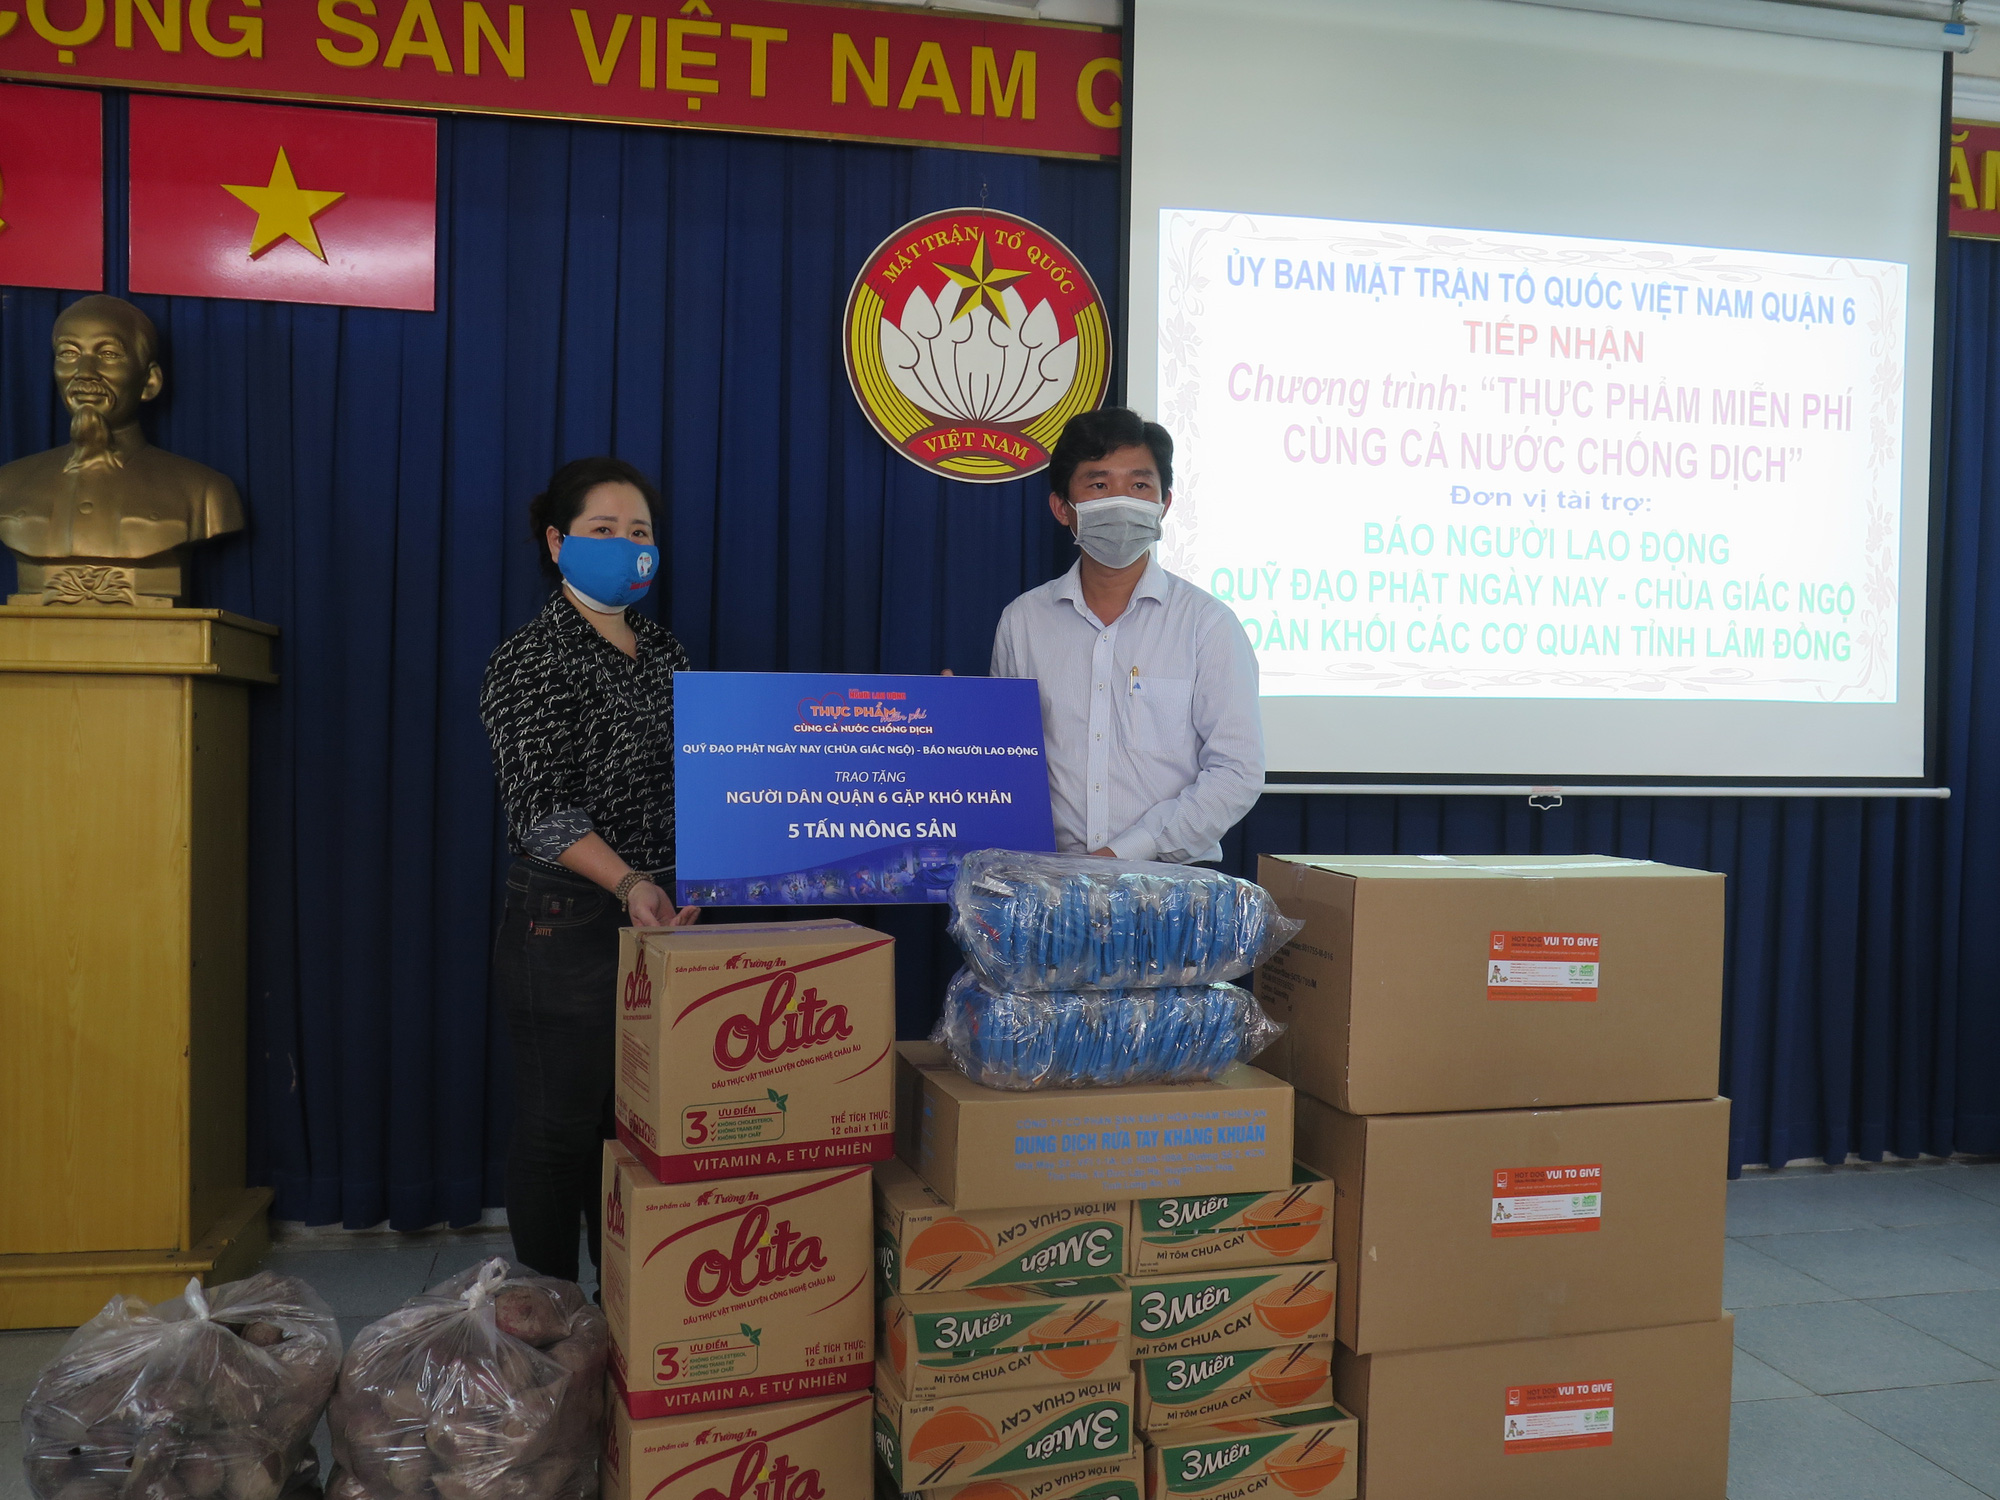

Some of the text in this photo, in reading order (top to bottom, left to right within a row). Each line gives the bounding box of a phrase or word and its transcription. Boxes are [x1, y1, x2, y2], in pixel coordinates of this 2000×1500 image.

[571, 0, 788, 111] VIỆT
[831, 32, 1036, 121] NAM
[881, 224, 1077, 296] MẶT TRẬN TỔ QUỐC
[1227, 247, 1856, 330] ỦY BAN MẶT TRẬN TỔ QUỐC VIỆT NAM QUẬN 6
[1463, 314, 1644, 370] TIẾP NHẬN
[1227, 362, 1370, 417] Chương
[1383, 371, 1467, 412] trình:
[1607, 376, 1700, 424] PHẨM
[1712, 381, 1790, 428] MIỄN
[1802, 387, 1853, 432] PHÍ
[922, 431, 1031, 462] VIỆT NAM
[1283, 416, 1386, 466] CÙNG
[1400, 421, 1449, 468] CẢ
[1461, 425, 1565, 473] NƯỚC
[1577, 431, 1697, 479] CHỐNG
[1450, 485, 1652, 516] Đơn vị tài trợ:
[1364, 515, 1730, 571] BÁO NGƯỜI LAO ĐỘNG
[1210, 561, 1855, 623] QUỸ ĐẠO PHẬT NGÀY NAY CHÙA GIÁC NGỘ
[1239, 610, 1851, 662] OÀN KHỐI CÁC CƠ QUAN TỈNH LÂM ĐỒNG
[810, 705, 852, 720] THỰC
[793, 722, 933, 735] CÙNG CẢ NƯỚC CHỐNG DỊCH
[682, 743, 1038, 759] QUỸ ĐẠO PHẬT NGÀY NAY (CHÙA GIÁC NGỘ) BÁO NGƯỜI LAO ĐỘNG
[834, 770, 906, 786] TRAO TẶNG
[726, 787, 1012, 808] NGƯỜI DÂN QUẬN 6 GẶP KHÓ KHĂN
[788, 817, 957, 839] 5 TẤN NÔNG SẢN
[1543, 936, 1560, 946] VUI
[1562, 937, 1574, 946] TO
[1577, 937, 1599, 947] GIVE
[727, 1076, 745, 1087] THỰC
[759, 1069, 774, 1078] TINH
[774, 1062, 796, 1073] LUYỆN
[796, 1058, 815, 1068] CÔNG
[834, 1047, 852, 1057] CHÂU
[686, 1110, 708, 1145] 3
[718, 1108, 732, 1117] ƯU
[831, 1112, 847, 1125] THỂ
[849, 1112, 867, 1123] TÍCH
[831, 1126, 840, 1136] 12
[841, 1125, 862, 1136] chai
[1014, 1134, 1057, 1155] DUNG
[1062, 1132, 1098, 1156] DỊCH
[1135, 1130, 1159, 1148] TAY
[1163, 1125, 1214, 1147] KHÁNG
[693, 1142, 872, 1172] VITAMIN A, E TỰ NHIÊN
[1546, 1169, 1562, 1180] VUI
[1565, 1169, 1577, 1178] TO
[1579, 1167, 1600, 1178] GIVE
[1157, 1233, 1246, 1260] MÌ TÔM CHUA CAY
[1135, 1313, 1253, 1356] MÌ TÔM CHUA CAY
[665, 1372, 847, 1408] VITAMIN A, E TỰ NHIÊN
[691, 1440, 825, 1500] lita
